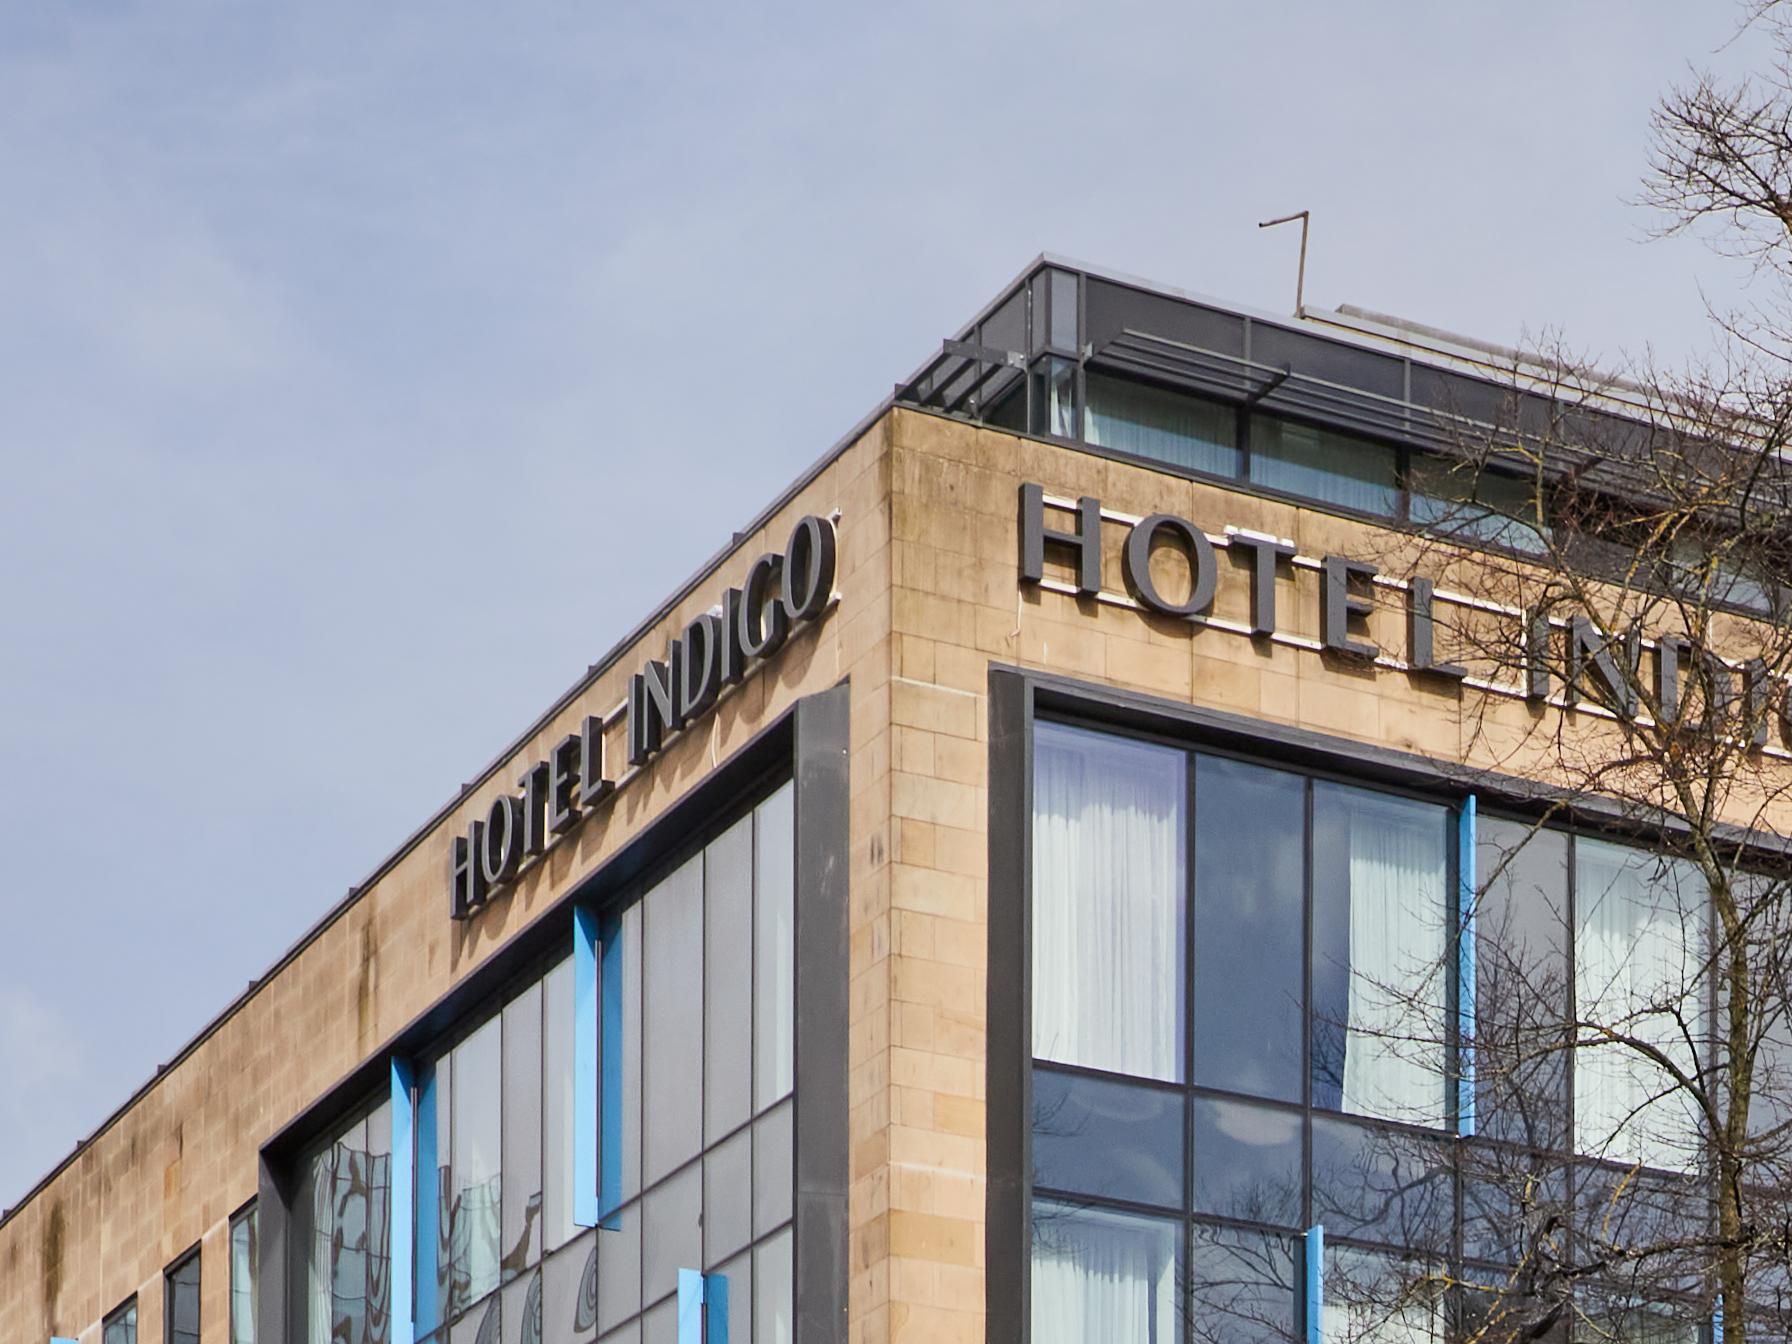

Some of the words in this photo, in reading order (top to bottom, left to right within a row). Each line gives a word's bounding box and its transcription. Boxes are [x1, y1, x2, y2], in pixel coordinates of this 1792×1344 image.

[449, 715, 615, 921] HOTEL
[628, 514, 837, 765] INDIGO
[1018, 482, 1468, 679] HOTEL
